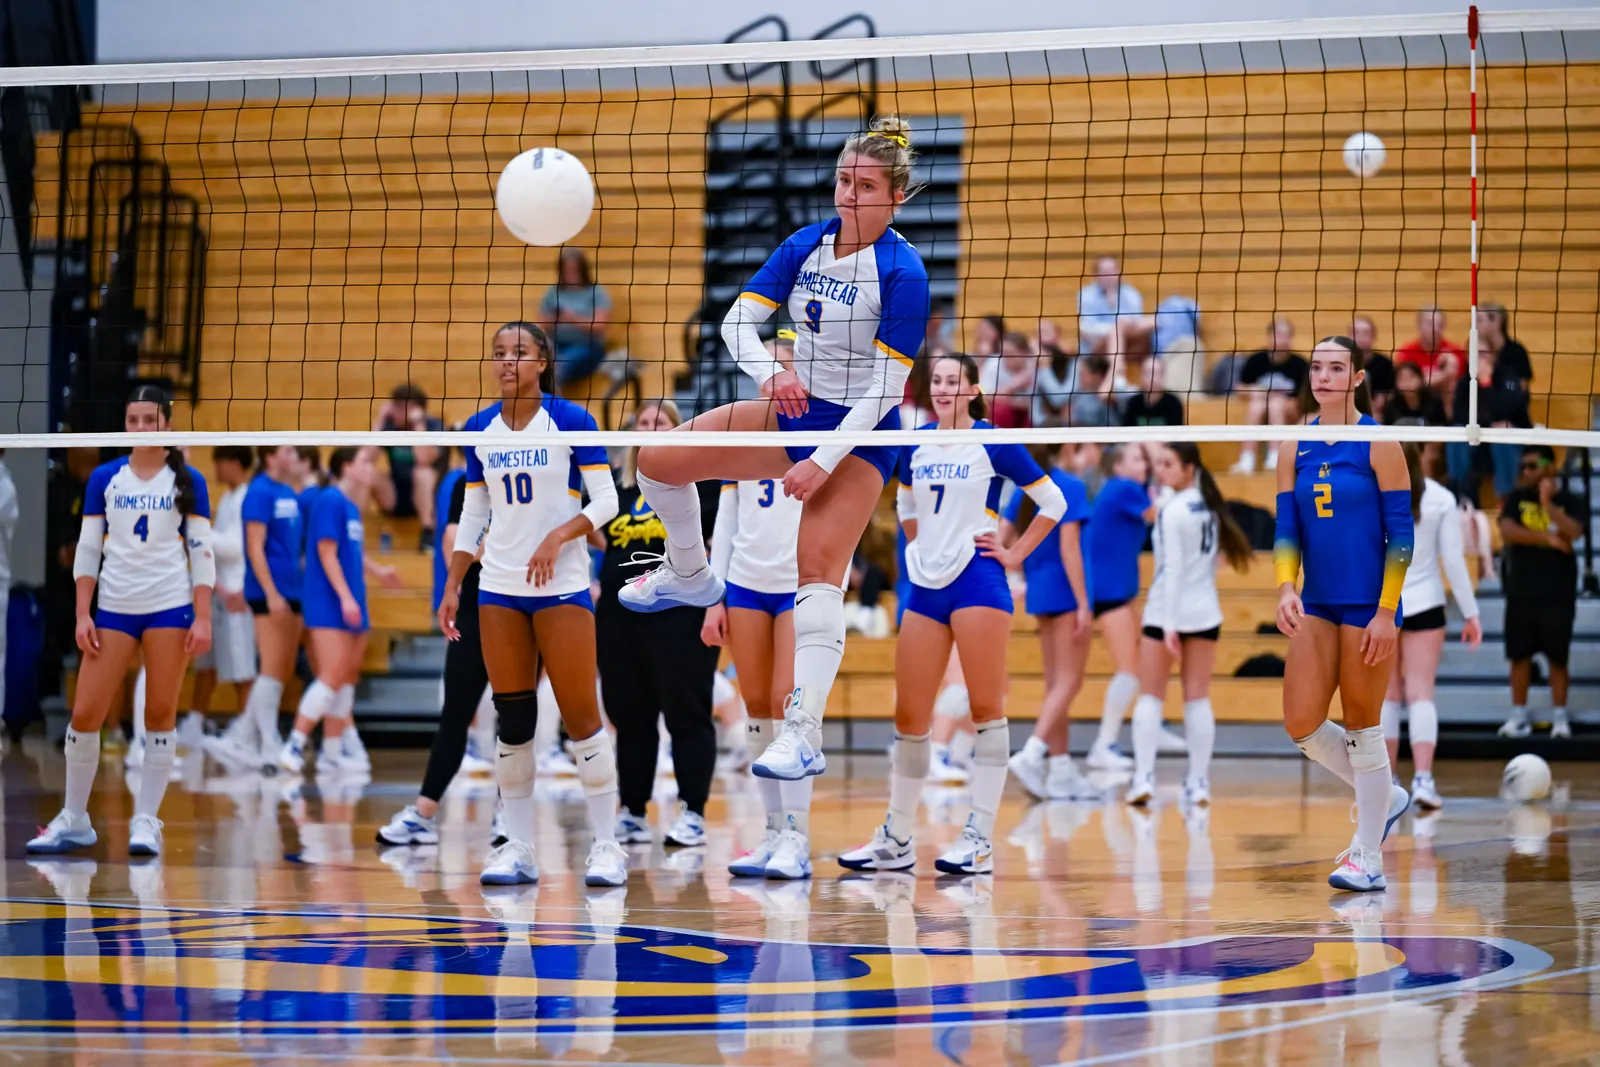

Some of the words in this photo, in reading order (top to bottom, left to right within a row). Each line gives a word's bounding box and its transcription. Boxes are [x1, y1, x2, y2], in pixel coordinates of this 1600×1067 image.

[804, 299, 823, 334] 9
[487, 448, 548, 469] HOMESTEAD
[114, 494, 172, 511] HOMESTEAD
[502, 472, 533, 505] 10
[757, 479, 775, 508] 3
[929, 484, 945, 515] 7
[1313, 483, 1334, 518] 2
[133, 514, 149, 543] 4
